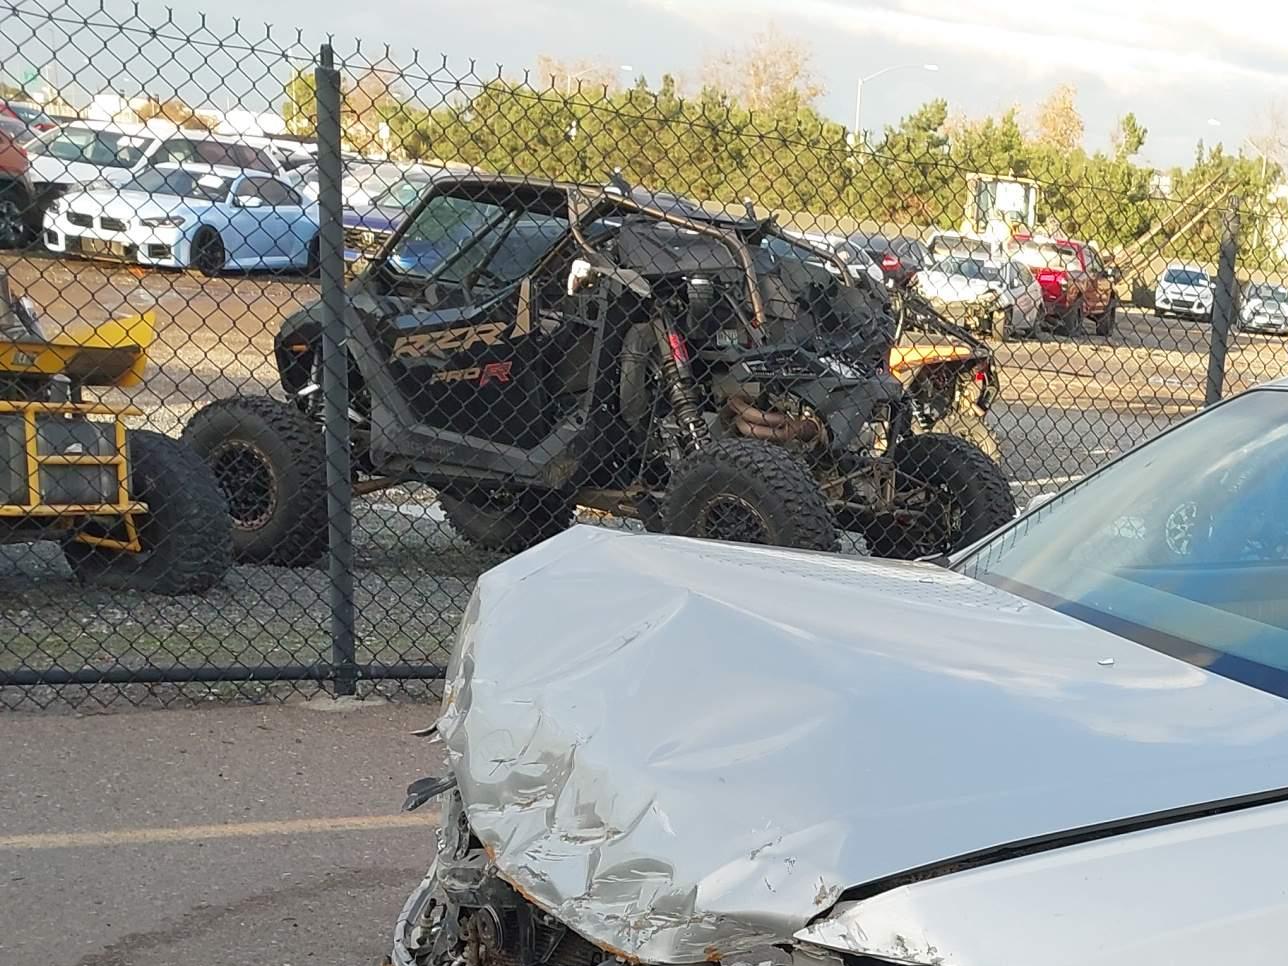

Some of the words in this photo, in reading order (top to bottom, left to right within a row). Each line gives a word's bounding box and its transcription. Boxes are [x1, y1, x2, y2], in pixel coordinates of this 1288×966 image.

[390, 322, 506, 363] RZR
[430, 367, 481, 385] PRO
[481, 361, 513, 388] R
